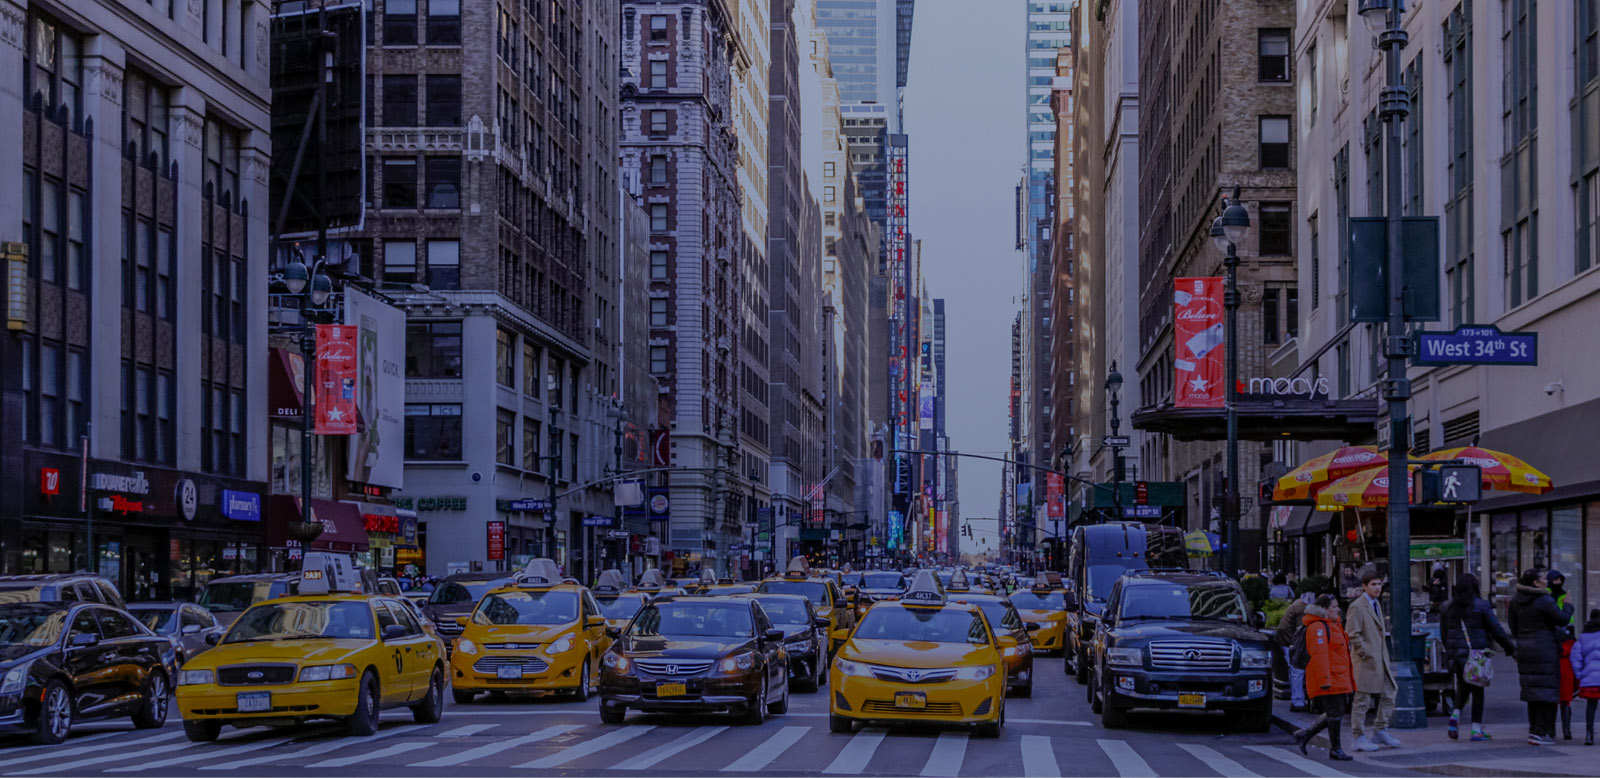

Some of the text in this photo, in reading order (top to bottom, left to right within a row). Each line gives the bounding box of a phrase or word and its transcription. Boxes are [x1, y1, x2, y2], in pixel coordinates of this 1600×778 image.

[1177, 305, 1218, 320] Believe
[317, 348, 352, 361] Believe
[1427, 339, 1528, 358] West 34th St
[1250, 373, 1329, 400] macy's
[277, 407, 298, 416] DELI
[185, 487, 194, 504] 24
[418, 498, 467, 511] COFFEE
[915, 592, 932, 600] 4K37
